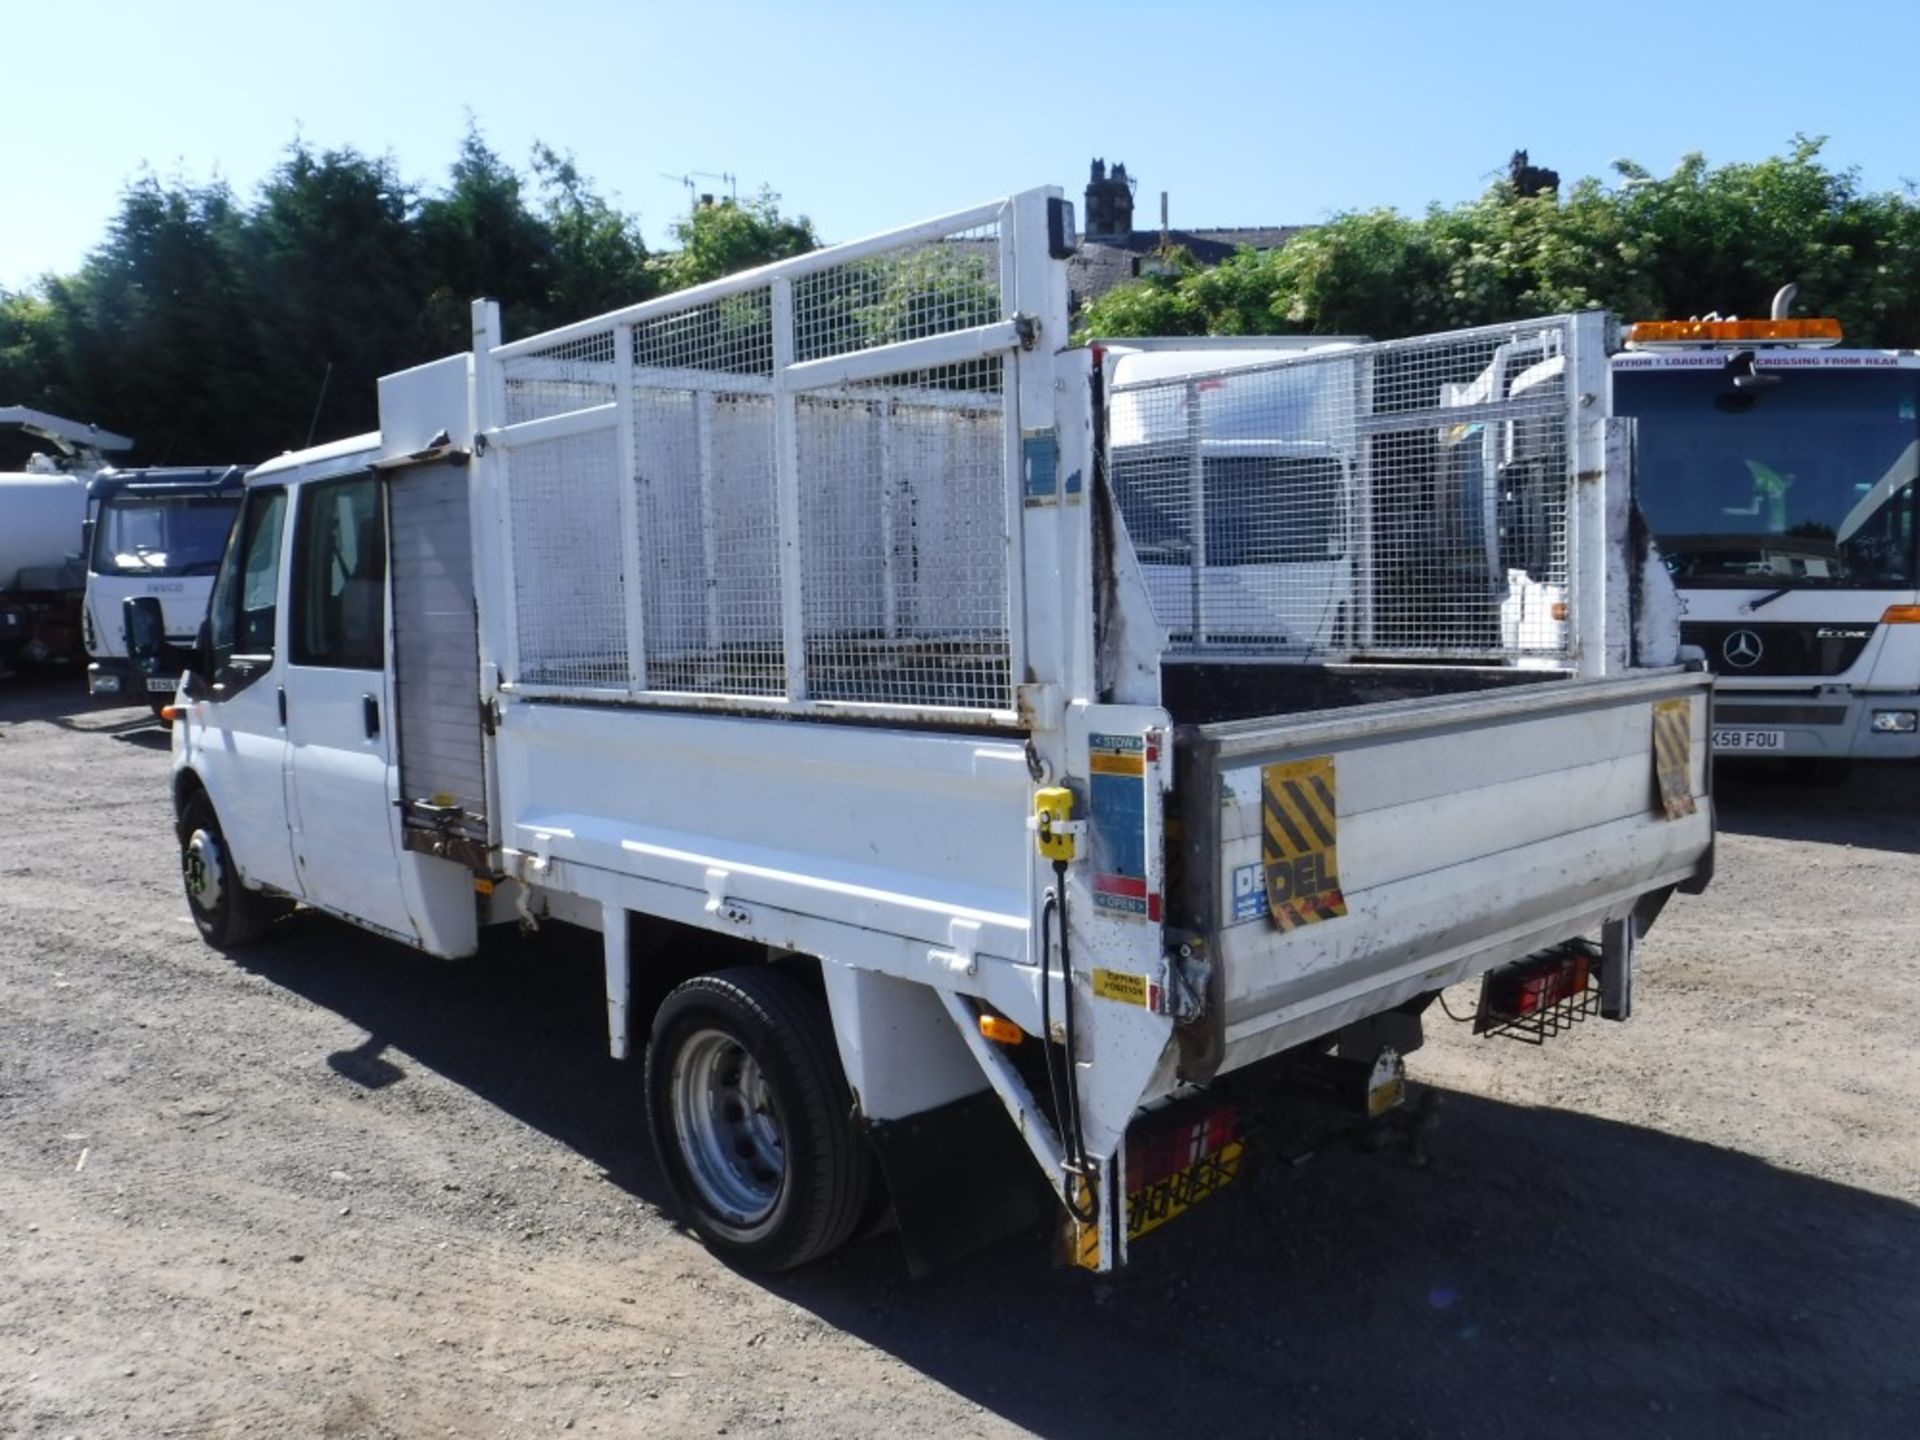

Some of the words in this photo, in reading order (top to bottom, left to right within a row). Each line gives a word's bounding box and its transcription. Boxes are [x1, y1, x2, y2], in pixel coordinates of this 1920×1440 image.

[1665, 357, 1723, 366] LOADERS
[1756, 357, 1821, 366] CROSSING
[1824, 357, 1862, 366] FROM
[1865, 356, 1898, 366] REAR
[1745, 732, 1777, 747] FOU
[1266, 853, 1340, 906] DEL
[1107, 896, 1136, 910] OPEN
[1104, 984, 1145, 996] POSITION
